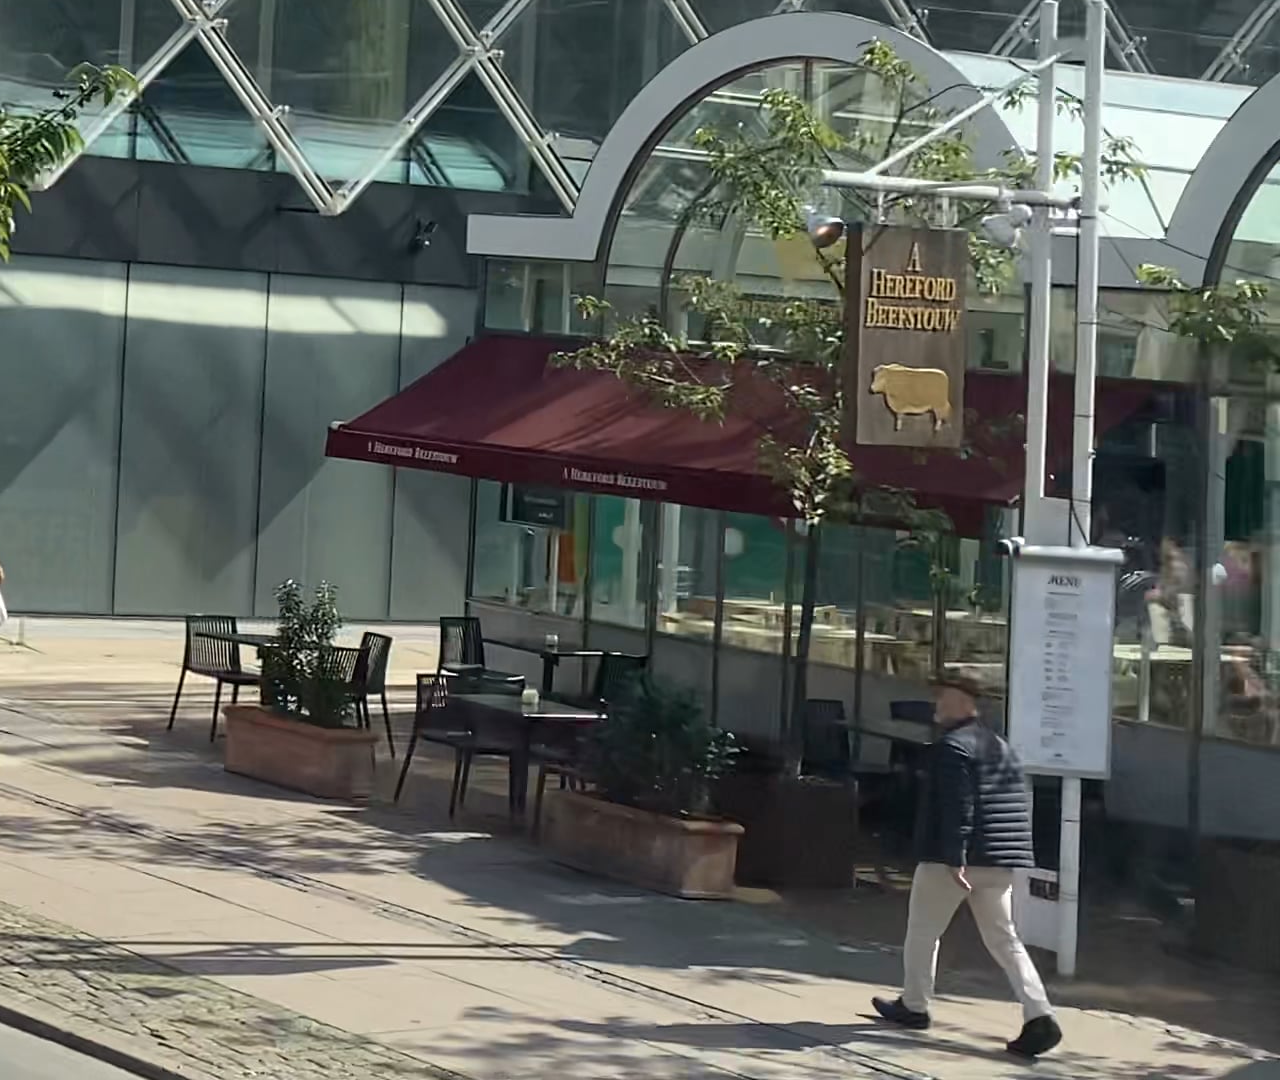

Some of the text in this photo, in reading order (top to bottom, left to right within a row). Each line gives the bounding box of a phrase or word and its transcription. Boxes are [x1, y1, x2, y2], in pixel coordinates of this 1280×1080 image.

[906, 241, 922, 271] A
[871, 267, 956, 301] HEREFORD
[865, 297, 962, 331] BEEFSTOUW
